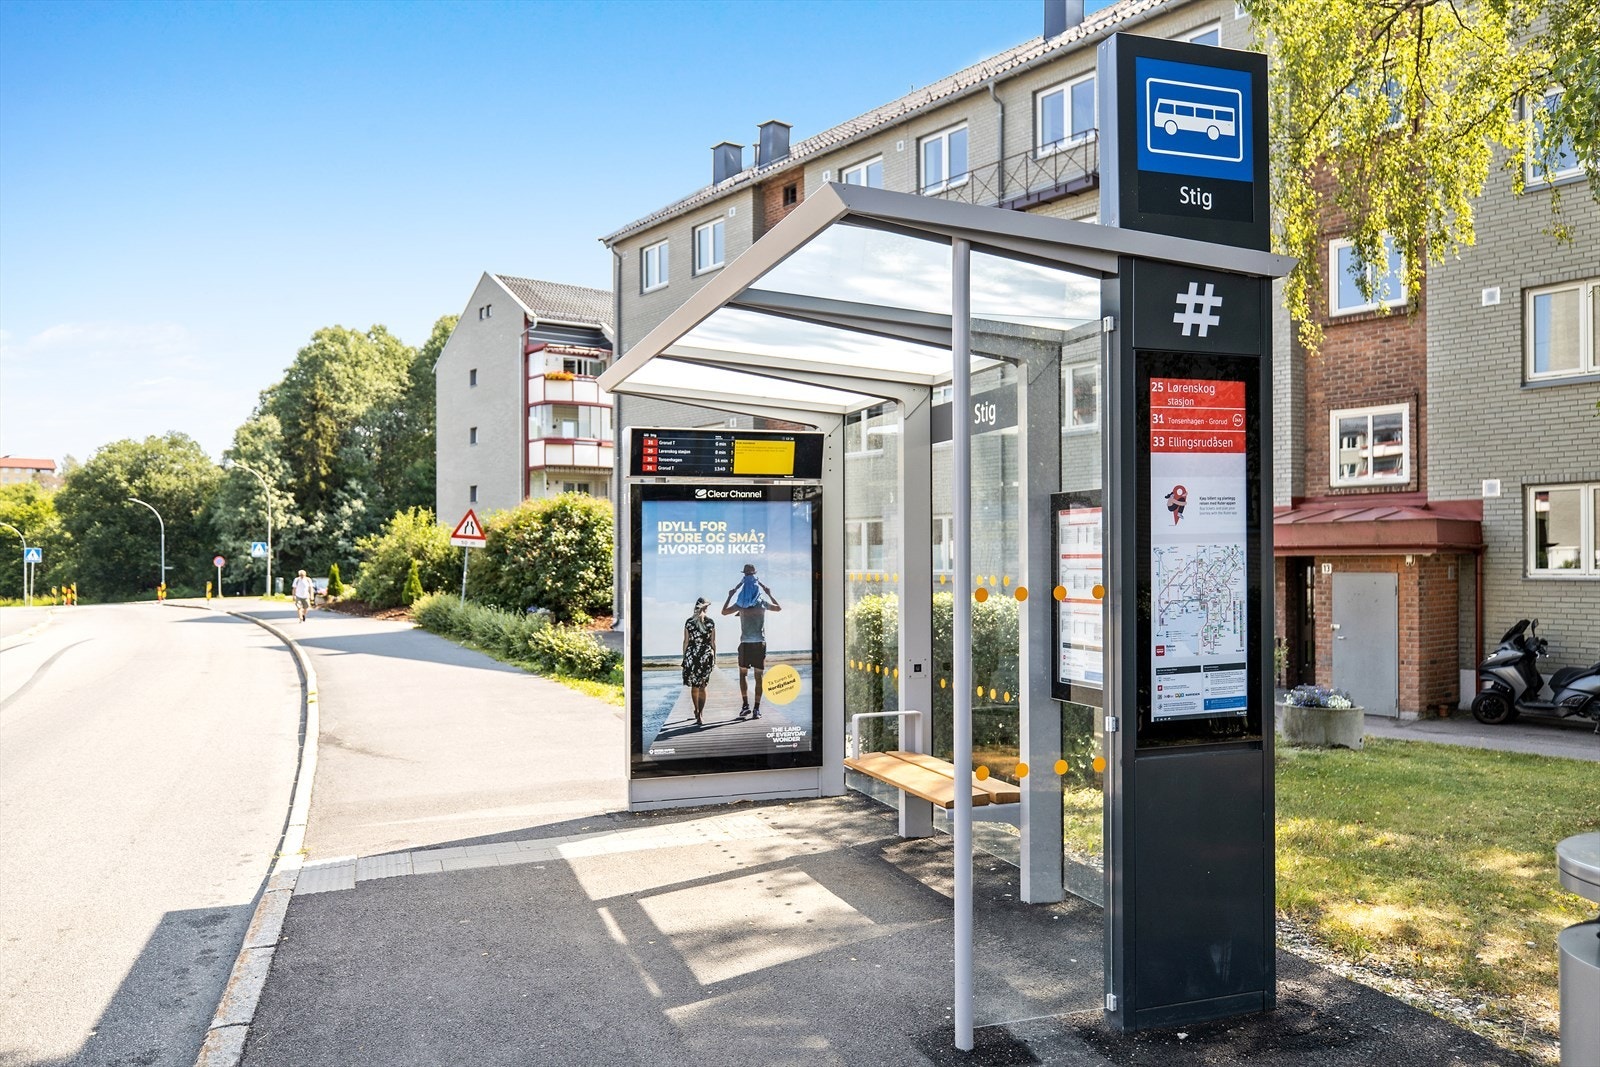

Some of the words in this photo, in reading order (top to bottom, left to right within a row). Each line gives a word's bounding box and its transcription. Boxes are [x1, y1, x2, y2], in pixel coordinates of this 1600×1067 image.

[1180, 186, 1212, 210] Stig
[1151, 382, 1164, 392] 25
[1168, 383, 1216, 396] Lørenskog
[1168, 397, 1195, 407] stasjon
[974, 401, 996, 425] Stig
[1152, 414, 1164, 424] 31
[1153, 437, 1165, 446] 33
[1168, 436, 1233, 449] Ellingsrudåsen
[707, 490, 728, 498] Clear
[729, 490, 762, 498] Channel
[657, 521, 697, 532] IDYLL
[700, 521, 727, 532] FOR
[658, 533, 702, 543] STORE
[706, 533, 725, 543] OG
[728, 529, 765, 543] SMÅ?
[658, 544, 724, 554] HVORFOR
[728, 544, 766, 554] IKKE?
